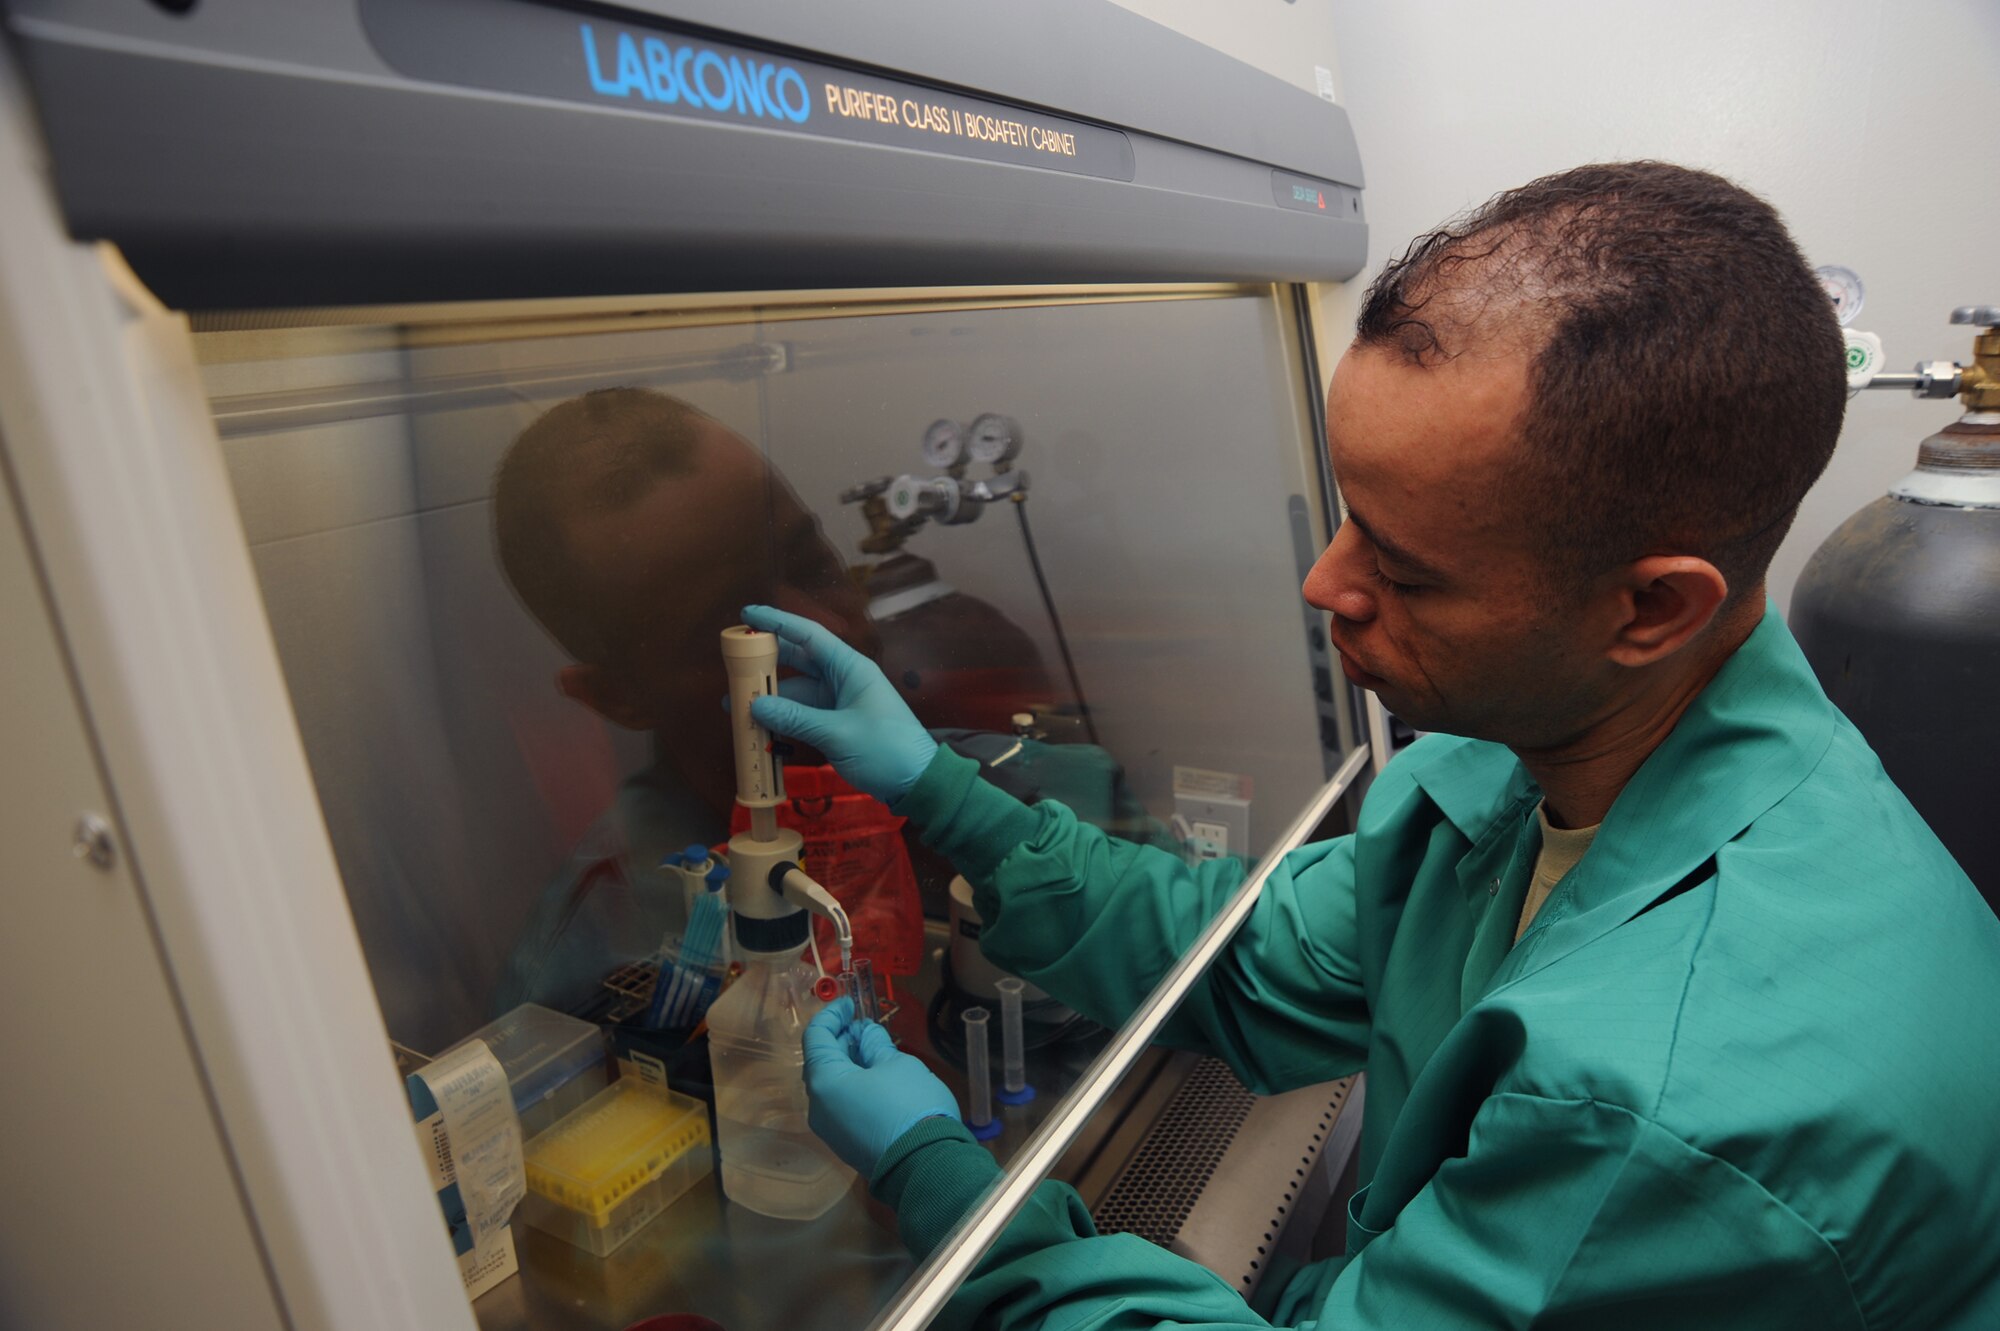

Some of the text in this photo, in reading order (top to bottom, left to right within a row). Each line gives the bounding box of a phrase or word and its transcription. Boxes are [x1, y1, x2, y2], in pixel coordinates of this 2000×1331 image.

[580, 23, 1076, 156] LABCONCO PURIFIER CLASS II BIOSAFETY CABINET
